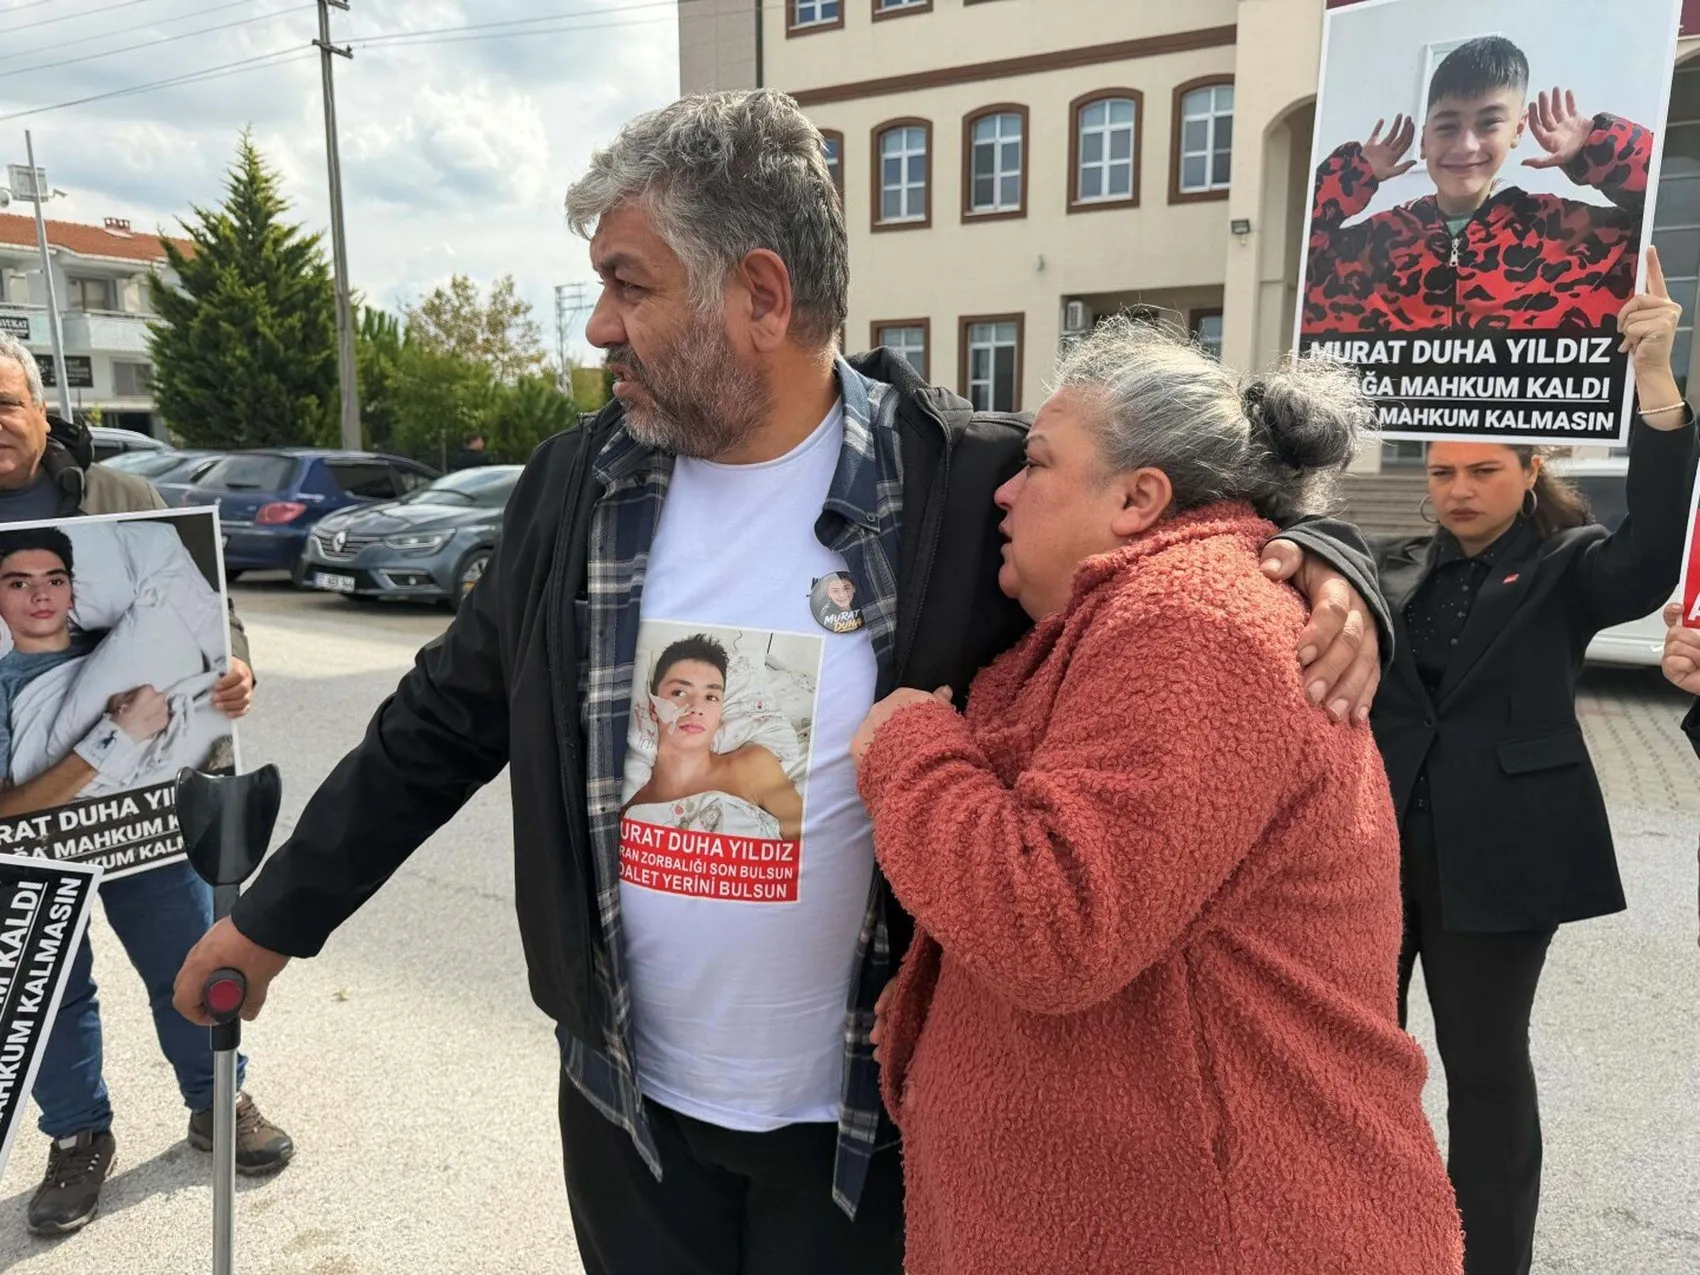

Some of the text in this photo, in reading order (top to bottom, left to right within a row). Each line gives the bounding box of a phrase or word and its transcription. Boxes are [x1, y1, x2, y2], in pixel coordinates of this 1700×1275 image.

[1310, 337, 1612, 364] MURAT DUHA YILDIZ
[1361, 371, 1610, 399] ĞA MAHKUM KALDI
[1379, 407, 1614, 431] MAHKUM KALMASIN
[824, 609, 860, 625] MURAT
[0, 815, 52, 846] RAT
[59, 797, 140, 832] DUHA
[53, 816, 163, 859] MAHKUM
[619, 820, 793, 862] URAT DUHA YILDIZ
[619, 844, 793, 880] RAN ZORBALIĞI SON BULSUN
[662, 872, 716, 895] YERİNİ
[719, 881, 787, 898] BULSUN
[17, 878, 82, 1013] KALMASIN
